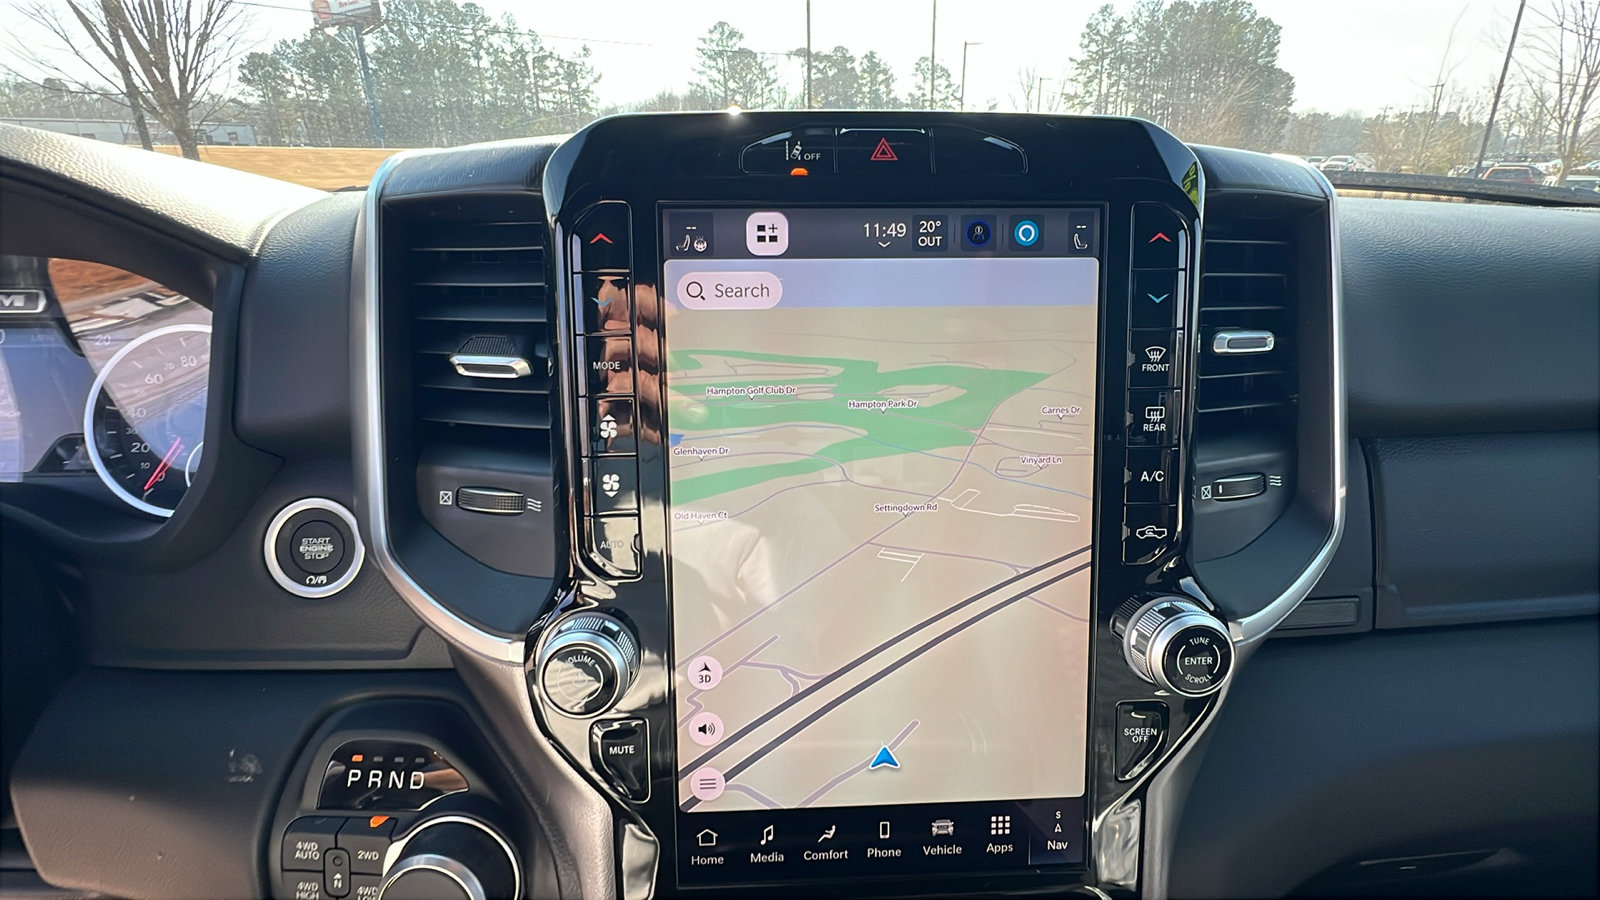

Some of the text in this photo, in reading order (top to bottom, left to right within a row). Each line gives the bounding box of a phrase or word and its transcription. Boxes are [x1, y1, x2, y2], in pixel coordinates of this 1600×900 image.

[804, 153, 821, 161] OFF
[863, 222, 907, 238] 11:49
[918, 220, 942, 234] 20°
[917, 236, 942, 247] OUT
[714, 282, 770, 298] Search
[180, 355, 197, 367] 80
[592, 361, 621, 370] MODE
[1141, 363, 1170, 372] FRONT
[144, 374, 163, 385] 60
[706, 386, 796, 396] Hampton Golf Club Dr
[848, 399, 918, 410] Hampton Park Dr
[126, 407, 147, 418] 40
[1041, 406, 1081, 415] Carnes Dr
[1143, 423, 1167, 432] REAR
[130, 442, 150, 453] 20
[673, 447, 729, 456] Glenhaven Dr
[1020, 455, 1062, 466] Vinyard Ln
[1140, 470, 1165, 482] A/C
[874, 502, 938, 513] Settingdown Rd
[674, 510, 728, 520] Old Haven Ct
[302, 537, 331, 545] START
[600, 540, 625, 549] AUTO
[299, 544, 334, 552] ENGINE
[304, 552, 330, 560] STOP
[1188, 636, 1211, 647] TUNE
[564, 654, 596, 667] OLUME
[1184, 656, 1213, 666] ENTER
[698, 674, 712, 684] 3D
[1185, 673, 1213, 684] SCROLL
[1124, 728, 1157, 736] SCREEN
[1132, 735, 1149, 743] OFF
[609, 745, 635, 755] MUTE
[296, 841, 318, 851] 4WD
[922, 844, 962, 856] Vehicle
[986, 843, 1013, 854] Apps
[1047, 840, 1068, 850] Nav
[294, 850, 320, 861] AUTO
[357, 850, 379, 861] 2WD
[750, 852, 784, 863] Media
[803, 849, 849, 861] Comfort
[867, 847, 902, 858] Phone
[691, 855, 724, 865] Home
[297, 881, 319, 891] 4WD
